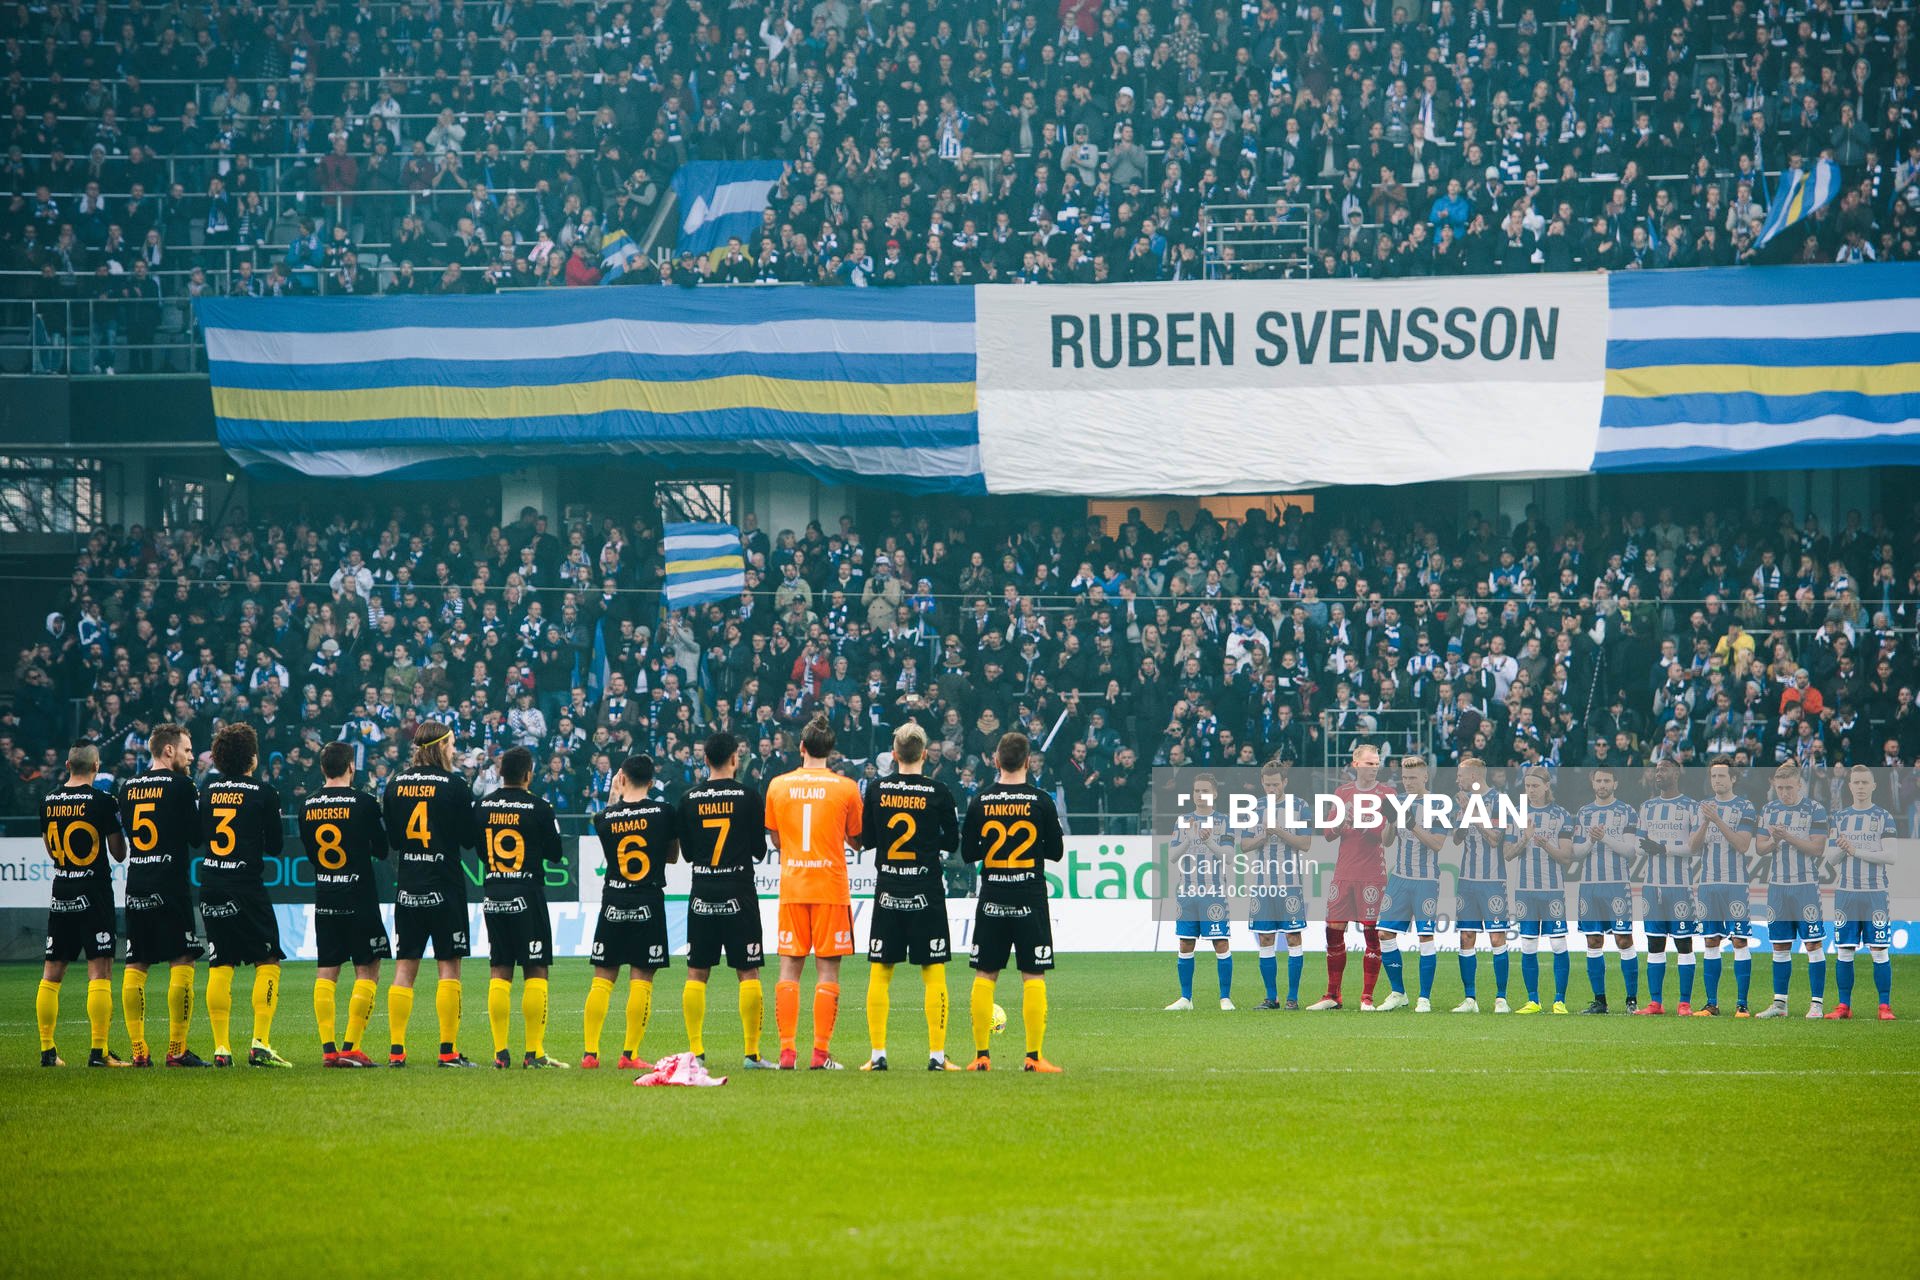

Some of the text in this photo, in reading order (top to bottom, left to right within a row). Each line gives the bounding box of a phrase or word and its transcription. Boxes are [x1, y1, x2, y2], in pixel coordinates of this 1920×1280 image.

[1052, 306, 1559, 369] RUBEN SVENSSON
[127, 787, 163, 800] FÄLLMAN
[211, 792, 243, 805] BORGES
[397, 785, 436, 798] PAULSEN
[789, 787, 826, 799] WILAND
[698, 801, 733, 815] KHALILI
[880, 794, 926, 810] SANDBERG
[46, 803, 85, 817] DJURDJIĆ
[305, 807, 350, 820] ANDERSEN
[983, 803, 1031, 817] TANKOVIĆ
[405, 801, 431, 848] 4
[488, 812, 520, 825] JUNIOR
[132, 803, 158, 851] 5
[210, 808, 236, 856] 3
[611, 818, 647, 834] HAMAD
[802, 803, 812, 852] 1
[47, 820, 100, 866] 40
[702, 817, 731, 866] 7
[887, 812, 917, 860] 2
[315, 823, 347, 870] 8
[485, 827, 525, 873] 19
[981, 820, 1037, 869] 22
[617, 834, 650, 882] 6
[899, 866, 918, 875] LINE
[1366, 908, 1375, 916] 12
[1210, 923, 1220, 932] 11
[1555, 920, 1562, 929] 9
[1679, 921, 1686, 930] 8
[1808, 925, 1820, 933] 24
[1874, 930, 1886, 939] 20
